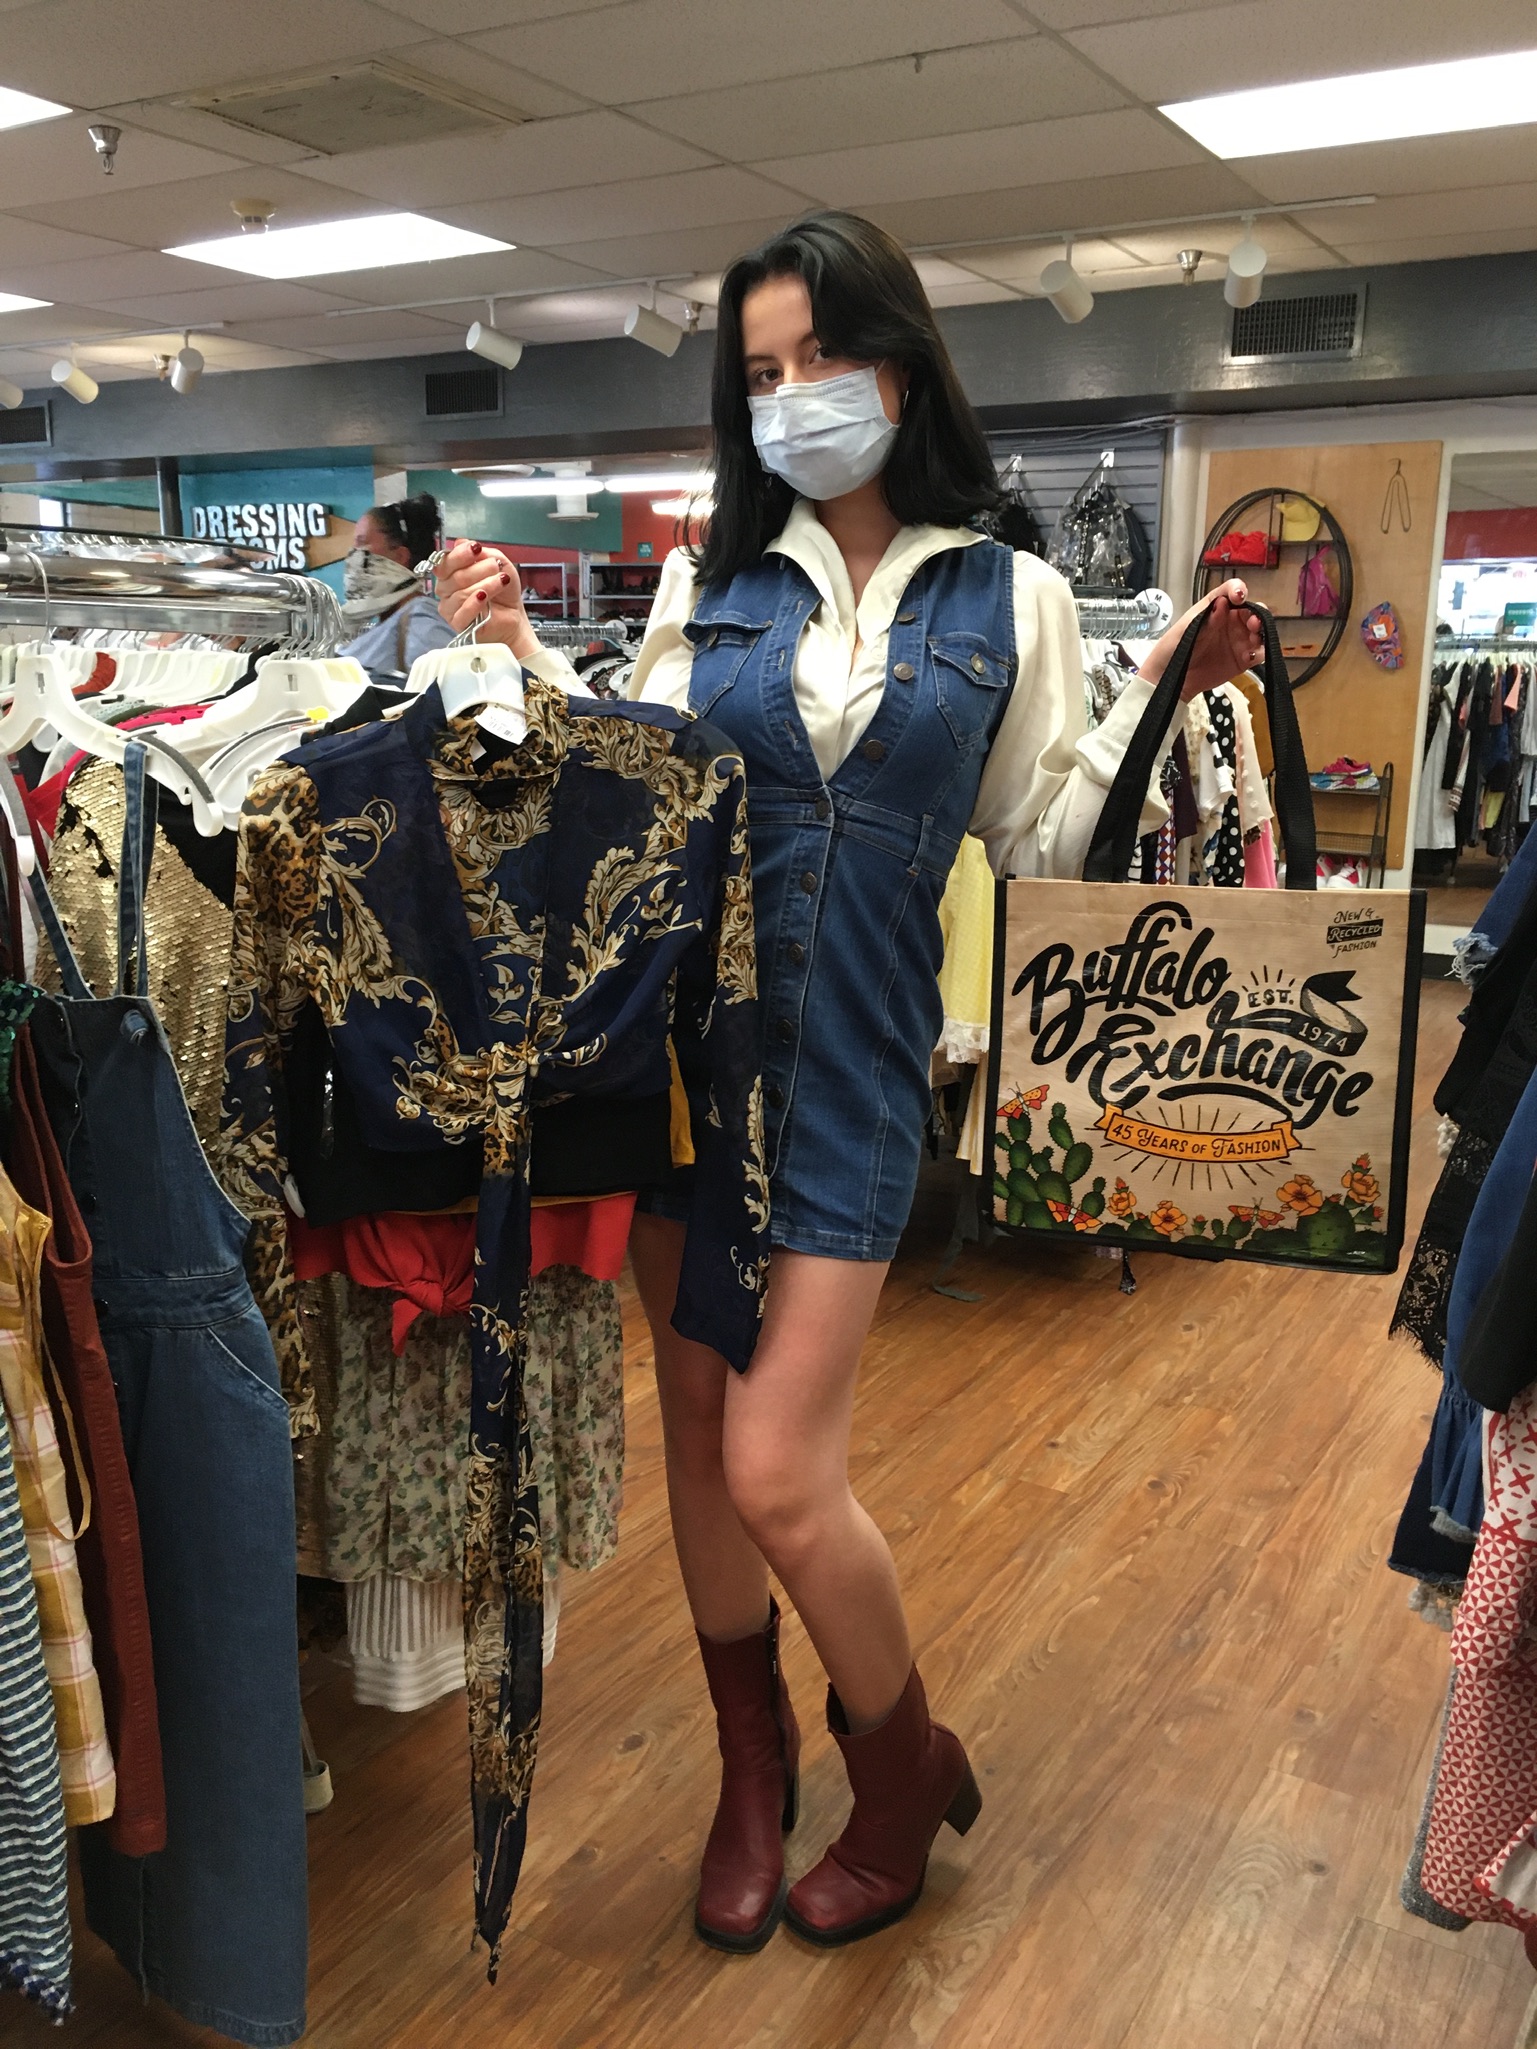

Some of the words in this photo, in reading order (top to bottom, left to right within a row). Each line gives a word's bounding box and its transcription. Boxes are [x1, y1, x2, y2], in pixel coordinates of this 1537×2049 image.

[192, 503, 326, 537] DRESSING
[214, 537, 305, 570] OMS
[1154, 593, 1163, 602] M
[1334, 908, 1364, 923] NEW
[1365, 908, 1375, 919] &
[1328, 924, 1380, 941] RECYCLED
[1332, 941, 1377, 958] FASHION
[1012, 901, 1231, 1065] Buffalo
[1247, 988, 1295, 1009] EST.
[1298, 1022, 1349, 1052] 1974
[1066, 990, 1373, 1129] Exchange
[1111, 1123, 1135, 1141] 45
[1137, 1129, 1188, 1152] YEARS
[1191, 1143, 1208, 1155] OF
[1211, 1138, 1281, 1158] FASHION
